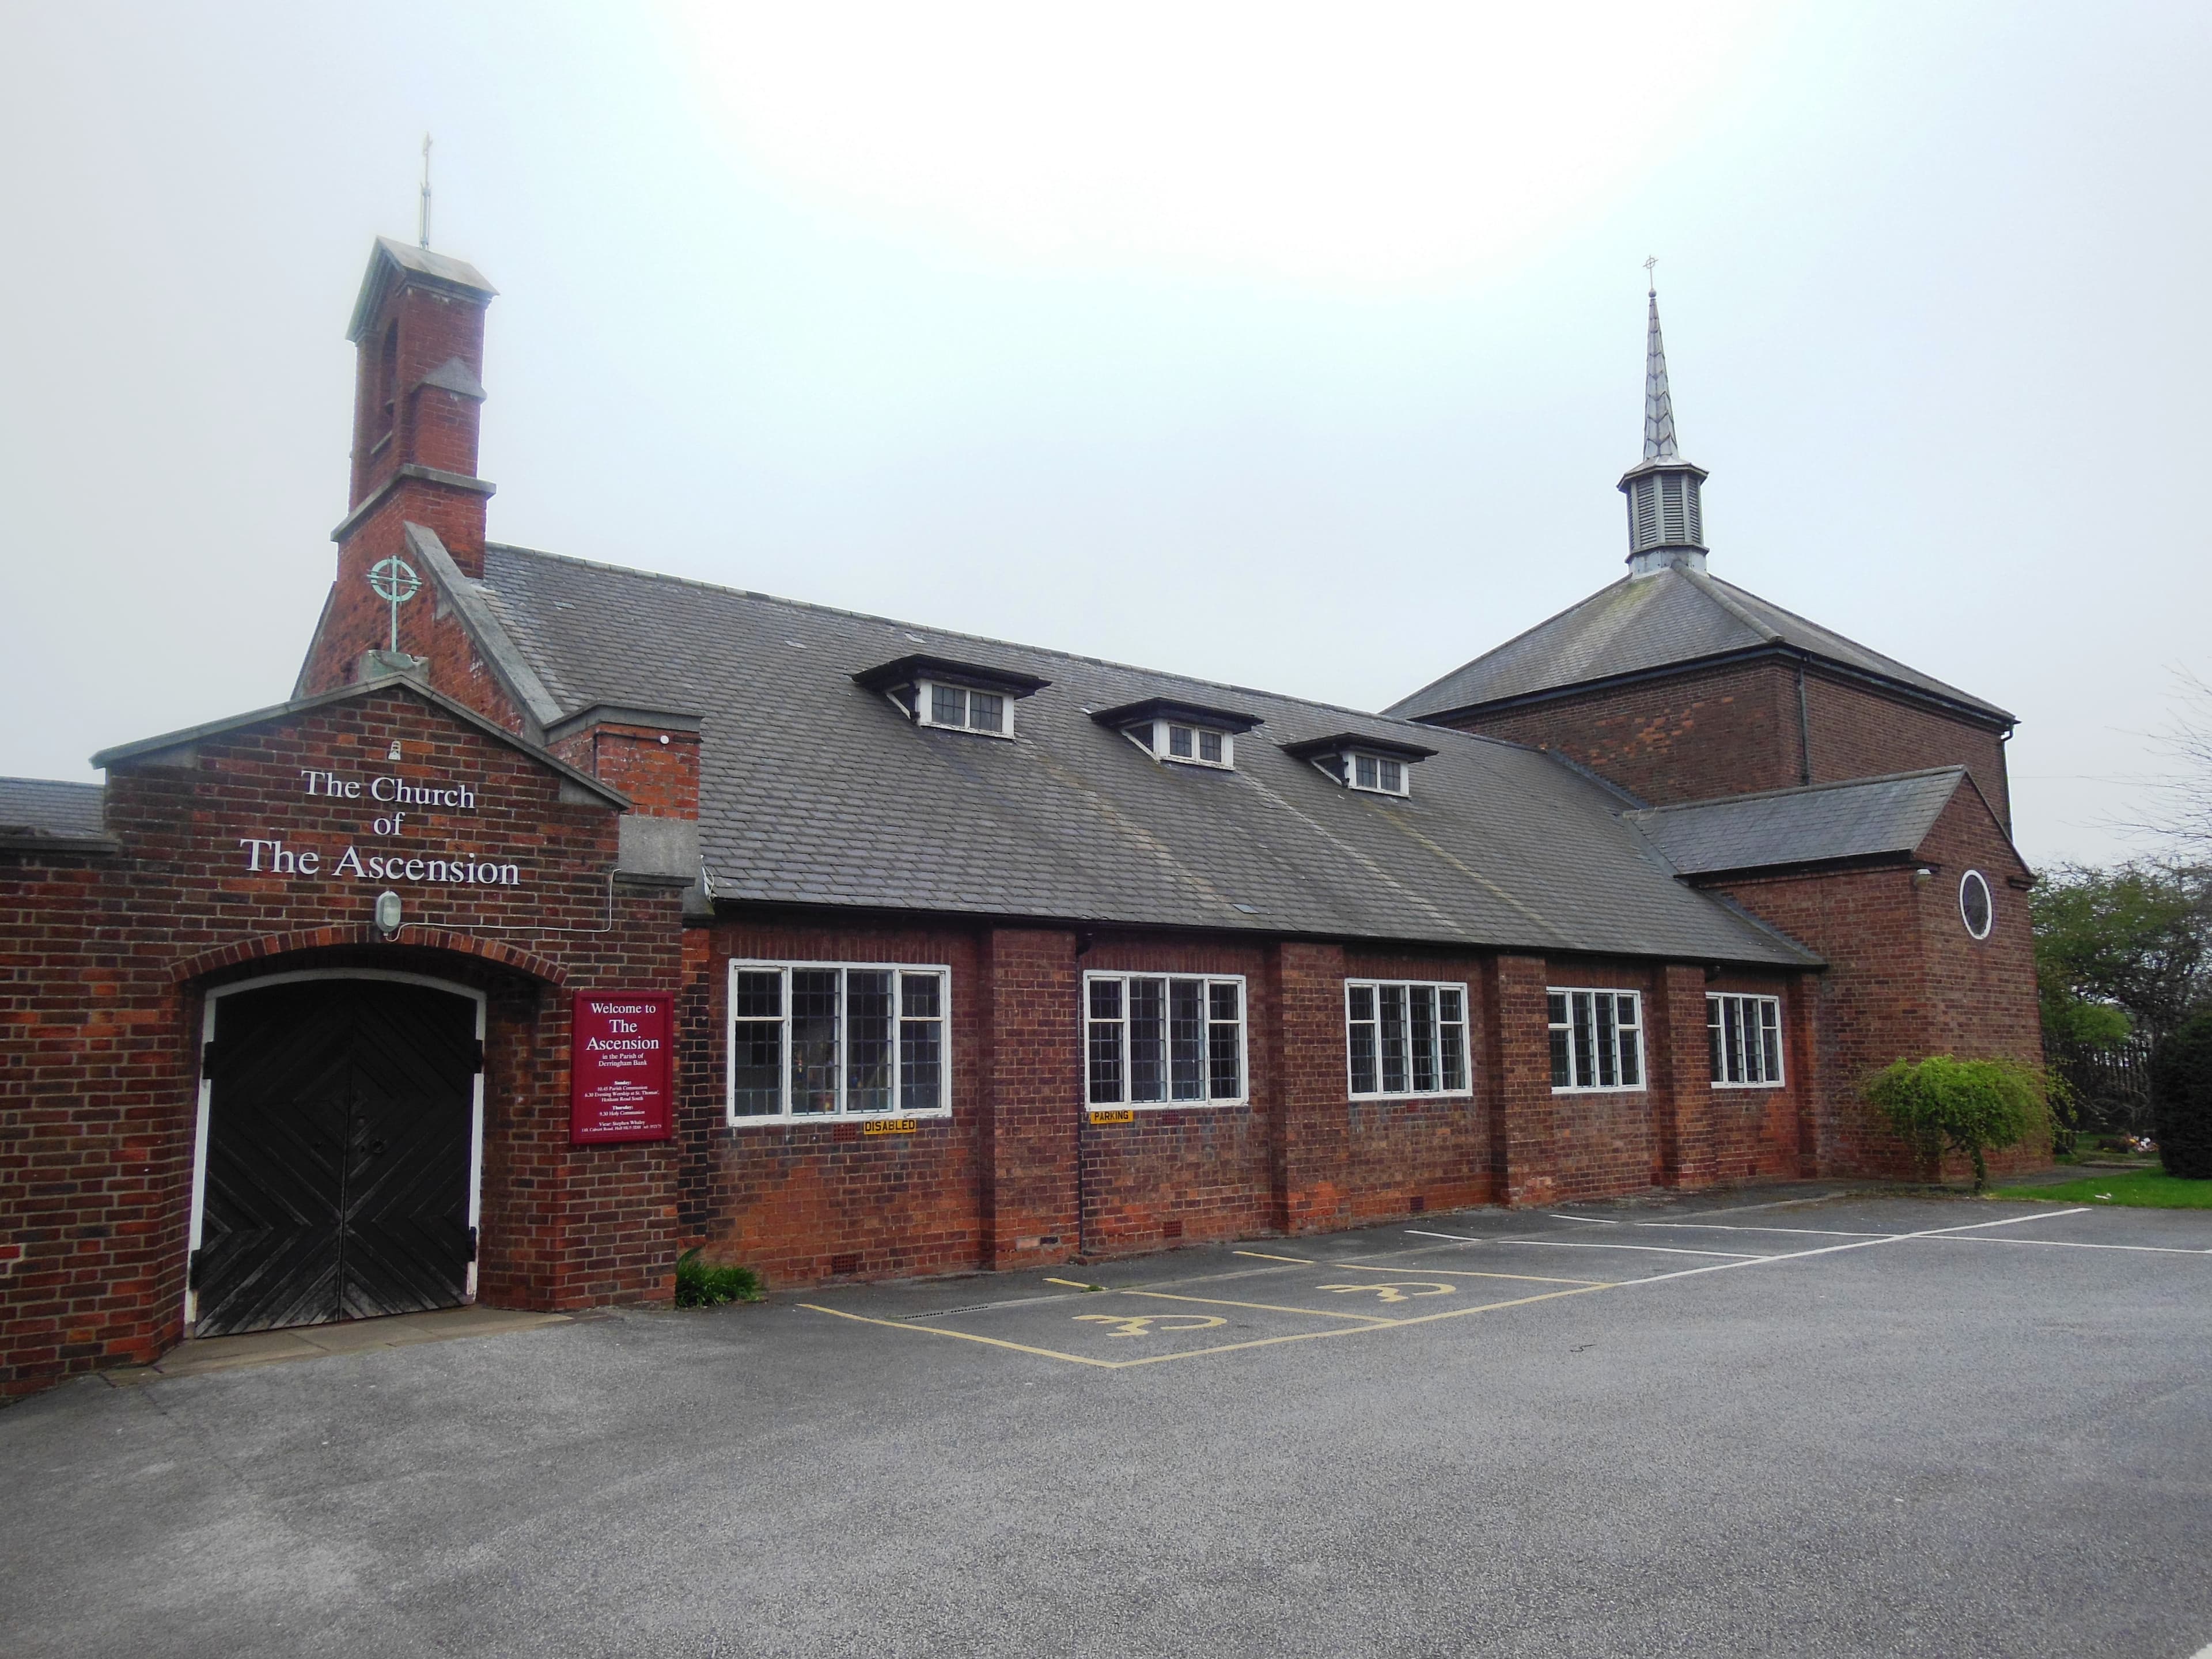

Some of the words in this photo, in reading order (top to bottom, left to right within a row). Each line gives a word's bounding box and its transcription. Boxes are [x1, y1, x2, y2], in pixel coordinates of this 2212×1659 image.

[301, 770, 361, 798] The
[371, 777, 475, 809] Church
[373, 812, 406, 836] of
[240, 838, 319, 875] The
[331, 846, 520, 885] Ascension
[591, 1003, 642, 1013] Welcome
[645, 1005, 656, 1013] to
[609, 1019, 638, 1033] The
[586, 1036, 659, 1050] Ascension
[1094, 1111, 1128, 1120] PARKING
[865, 1120, 915, 1131] DISABLED
